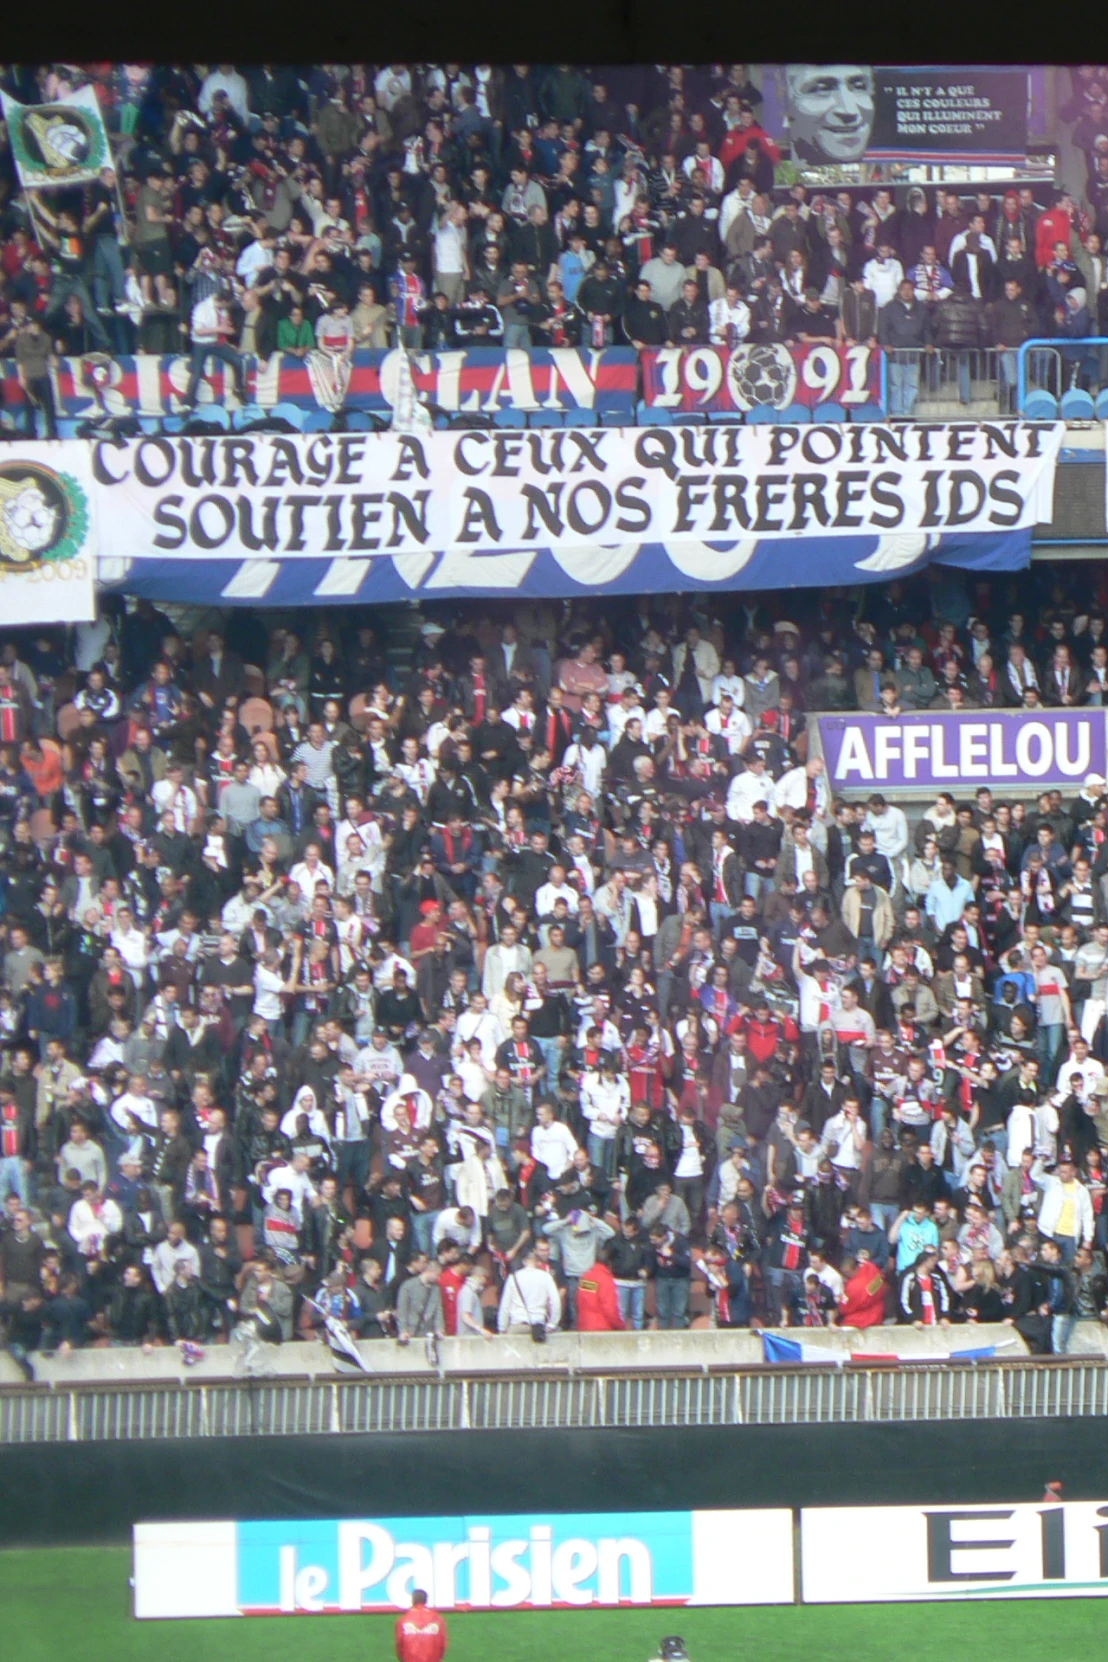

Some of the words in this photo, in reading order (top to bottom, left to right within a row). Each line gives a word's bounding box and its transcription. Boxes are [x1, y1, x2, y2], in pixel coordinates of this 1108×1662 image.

[896, 86, 908, 96] IL
[935, 86, 946, 96] A
[947, 85, 974, 97] QUE
[896, 98, 921, 109] CES
[922, 97, 991, 109] COULEURS
[896, 110, 921, 122] QUI
[922, 109, 1002, 121] ILLUMINENT
[896, 123, 926, 134] MON
[928, 123, 973, 134] COEUR
[380, 347, 608, 413] CLAN
[92, 434, 368, 487] COURAGE
[391, 435, 431, 481] A
[454, 430, 609, 477] CEUX
[634, 427, 742, 482] QUI
[766, 423, 1055, 467] POINTENT
[153, 489, 432, 552] SOUTIEN
[456, 485, 504, 543] A
[520, 475, 653, 540] NOS
[672, 470, 906, 533] FRERES
[918, 467, 1025, 529] IDS
[834, 721, 1090, 780] AFFLELOU
[279, 1545, 328, 1612] le
[338, 1522, 652, 1610] Parisien
